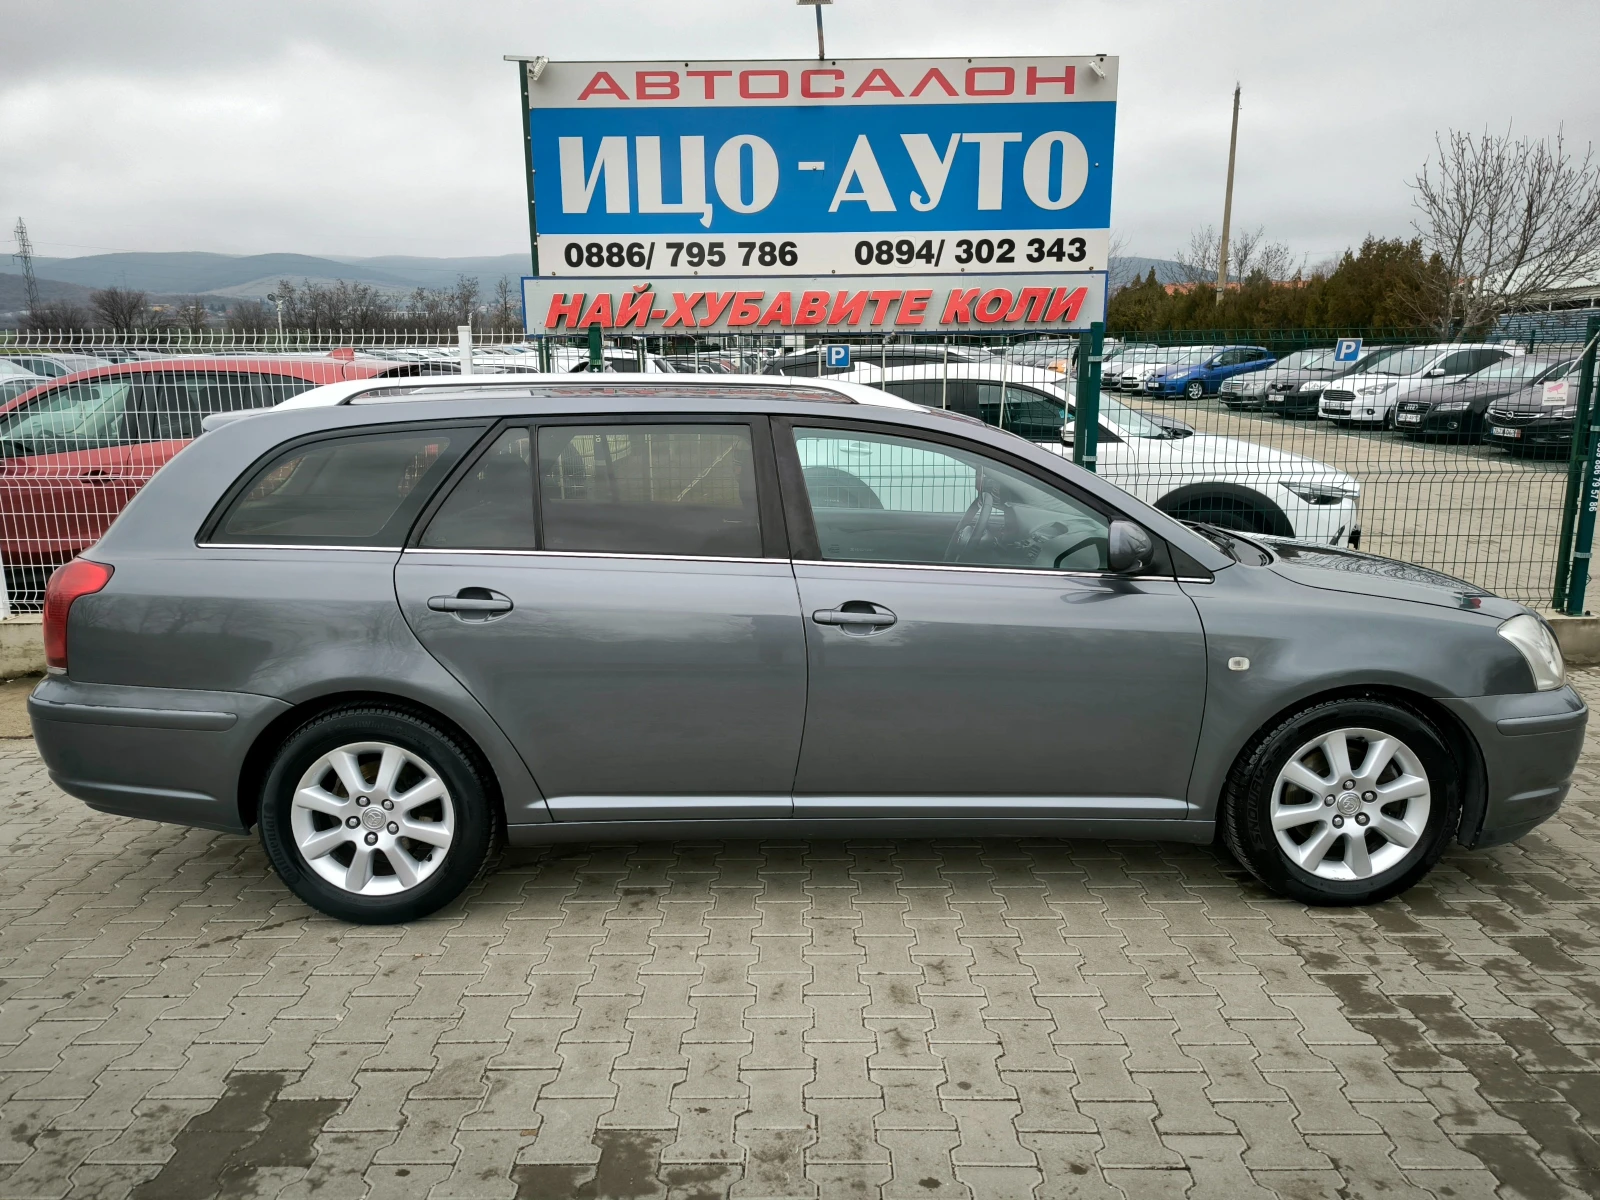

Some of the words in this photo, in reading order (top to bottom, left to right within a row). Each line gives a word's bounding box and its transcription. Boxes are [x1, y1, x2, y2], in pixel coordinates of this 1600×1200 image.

[577, 67, 1075, 100] АВТОСАЛОН
[666, 241, 726, 267] 795
[737, 241, 799, 266] 786
[954, 238, 1016, 264] 302
[1025, 237, 1087, 263] 343
[544, 282, 933, 328] НАЙ-ХУБАВИТЕ
[940, 286, 1088, 325] КОЛИ
[831, 347, 845, 365] P
[1339, 341, 1356, 359] P
[1588, 501, 1598, 512] 86
